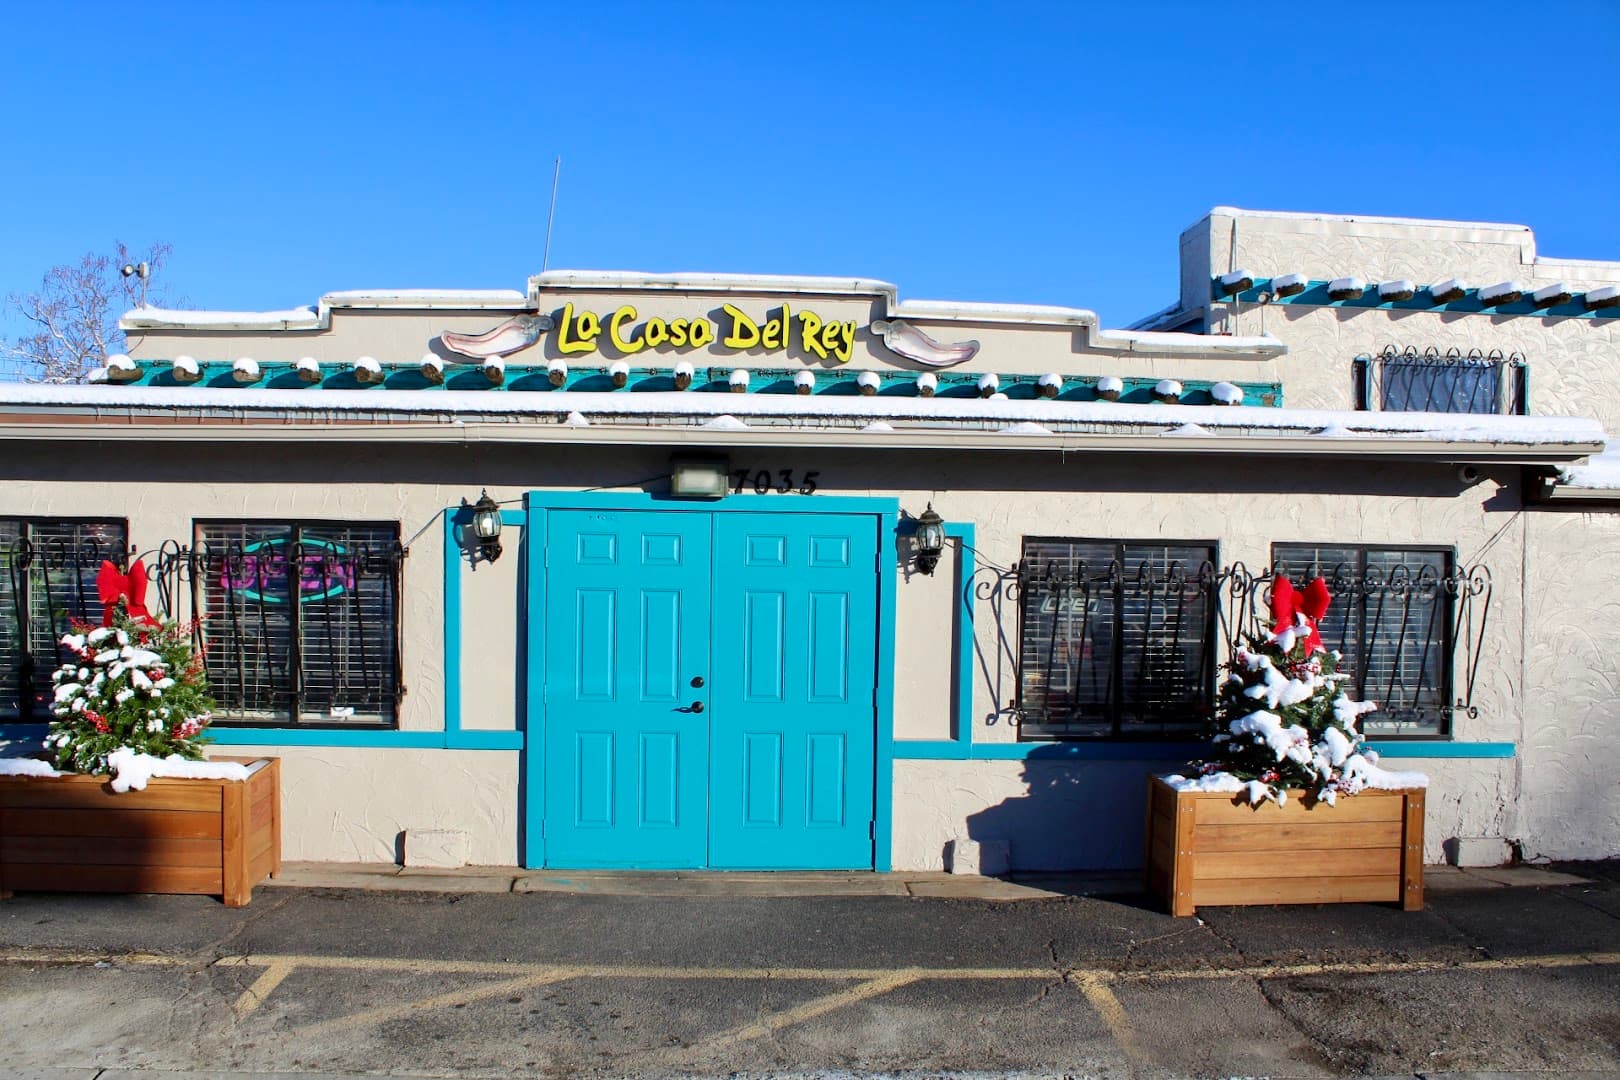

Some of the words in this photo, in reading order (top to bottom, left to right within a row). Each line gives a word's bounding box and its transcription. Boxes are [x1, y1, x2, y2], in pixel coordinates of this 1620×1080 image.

[558, 302, 601, 353] La
[610, 304, 714, 353] Casa
[723, 303, 790, 349] Del
[798, 309, 857, 362] Rey
[734, 469, 820, 496] 7035
[220, 555, 356, 590] OPEN
